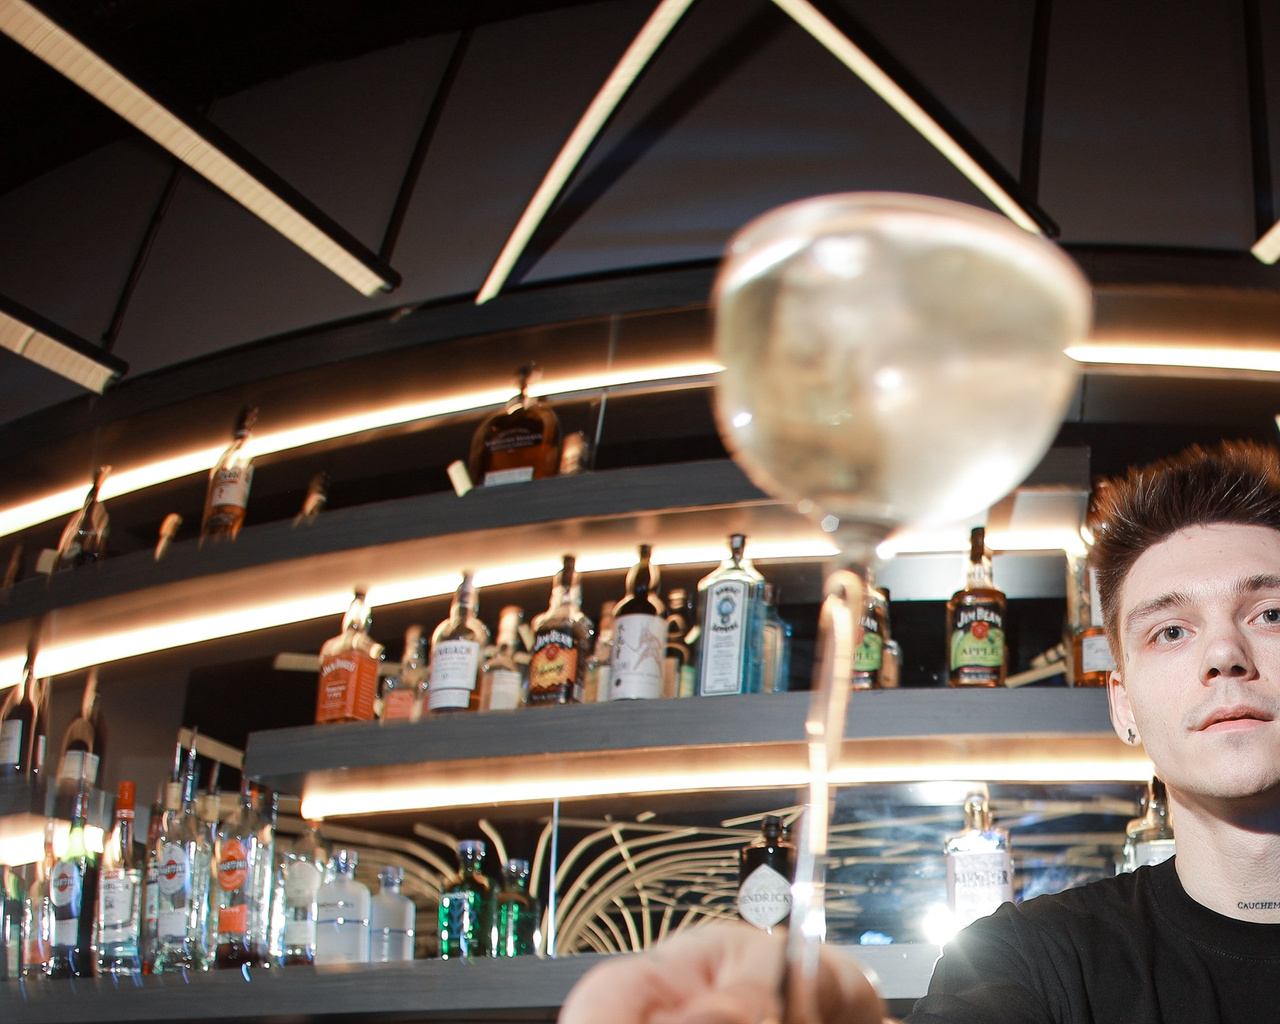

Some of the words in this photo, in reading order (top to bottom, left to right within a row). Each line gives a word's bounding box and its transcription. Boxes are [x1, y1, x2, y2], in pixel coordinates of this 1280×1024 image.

[957, 611, 976, 628] JIM
[976, 607, 1002, 628] BEAM
[961, 647, 999, 657] APPLE
[741, 893, 791, 905] ENDRICK
